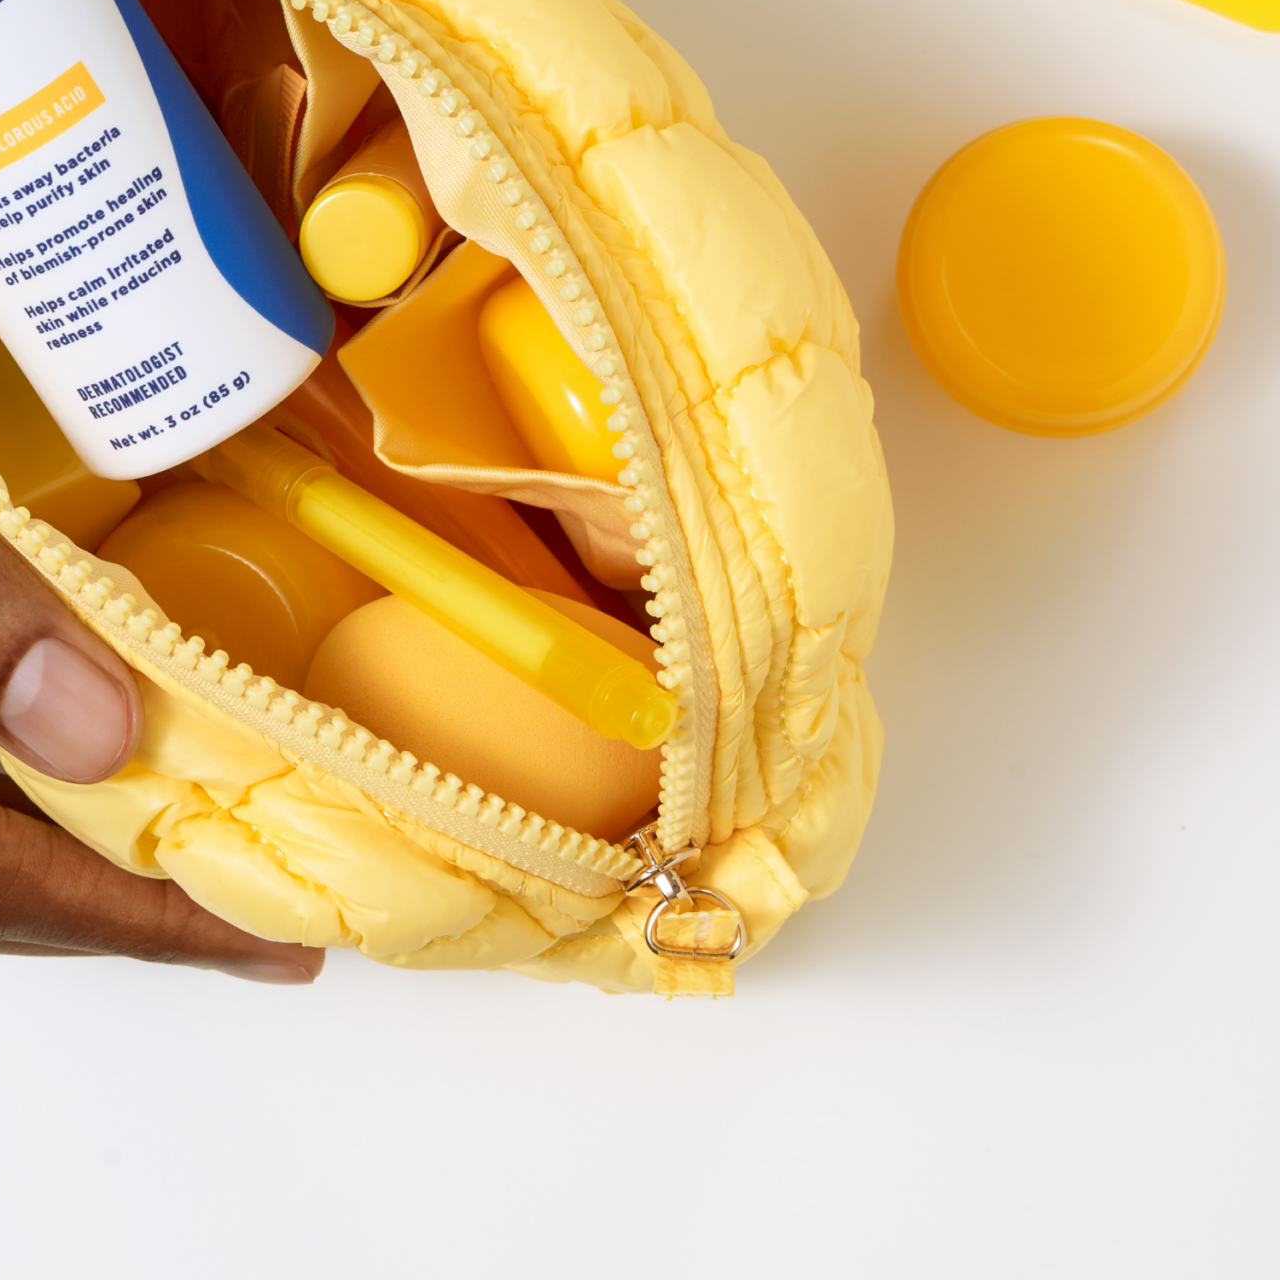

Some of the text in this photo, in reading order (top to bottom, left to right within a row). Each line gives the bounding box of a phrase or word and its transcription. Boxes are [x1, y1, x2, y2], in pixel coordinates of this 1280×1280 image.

[54, 86, 86, 118] ACID
[12, 170, 54, 200] away
[54, 124, 121, 176] bacteria
[25, 181, 75, 218] purify
[77, 156, 111, 185] skin
[5, 186, 168, 286] of blemish-prone skin
[36, 208, 106, 255] promote
[106, 165, 163, 215] healing
[24, 295, 66, 319] Helps
[67, 275, 107, 302] calm
[36, 248, 182, 335] skin while reducing
[46, 320, 104, 350] redness
[77, 342, 183, 402] DERMATOLOGIST
[88, 365, 187, 419] RECOMMENDED
[109, 370, 250, 451] Net wt. 3 oz (85 g)
